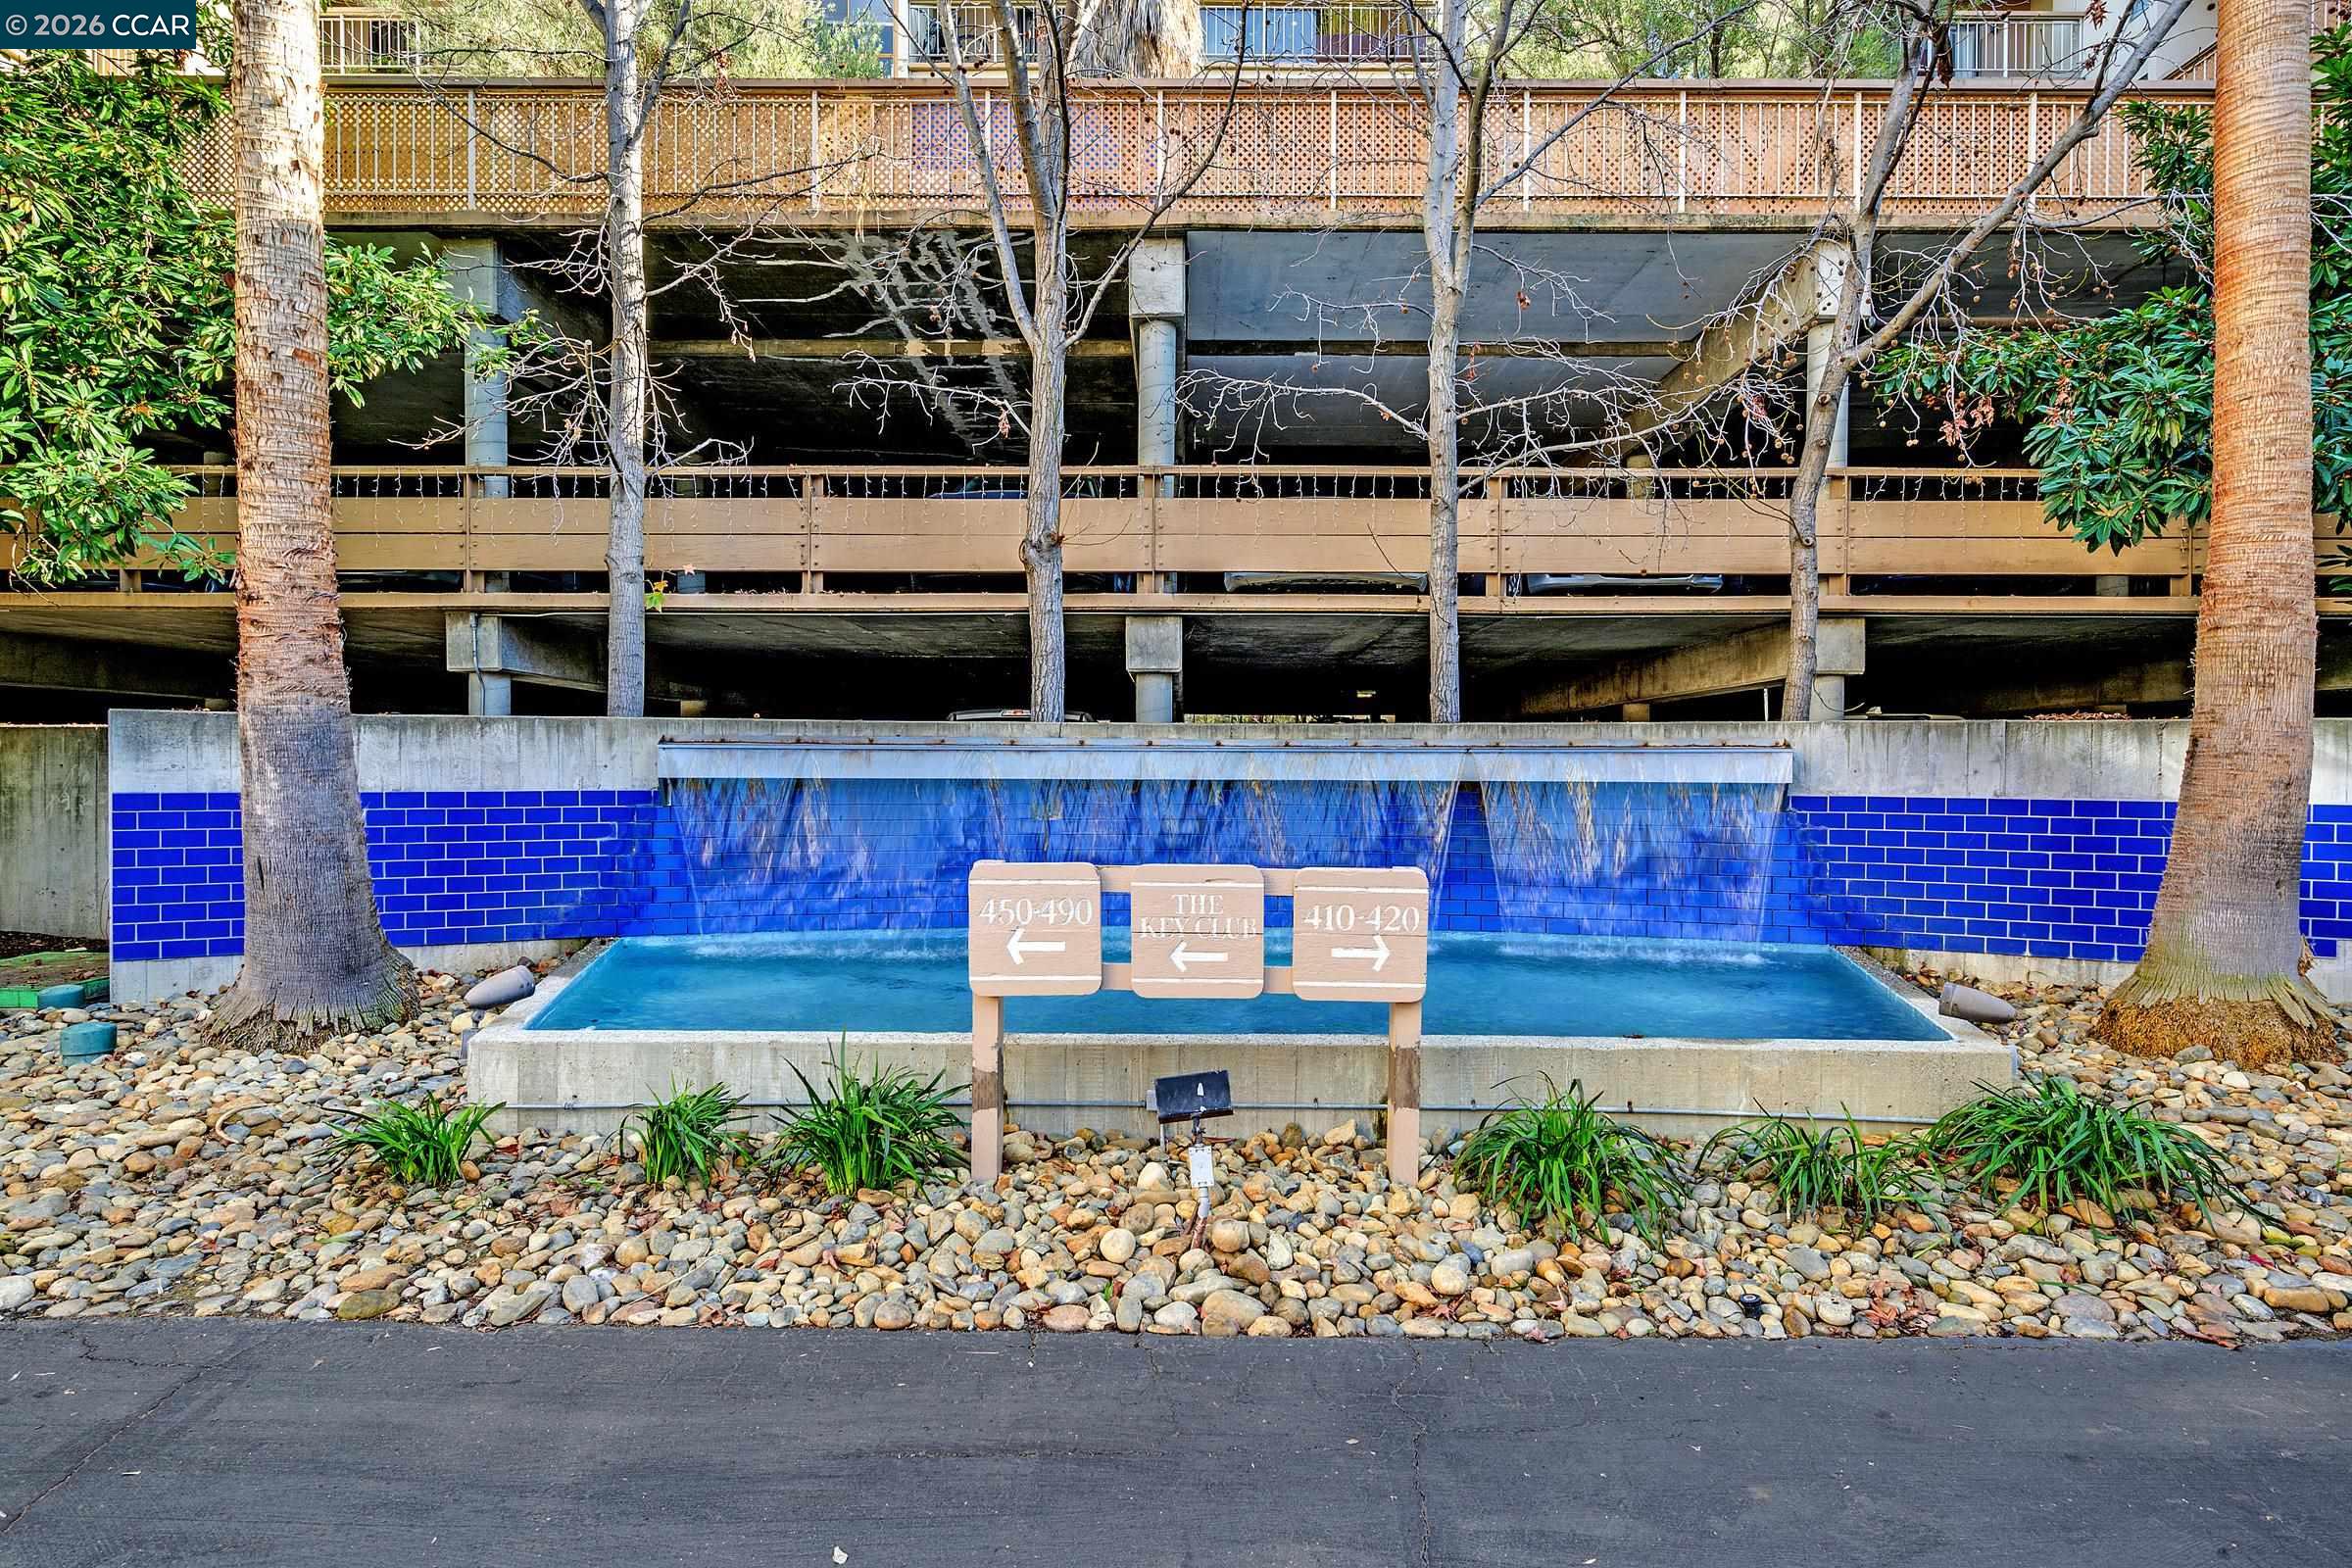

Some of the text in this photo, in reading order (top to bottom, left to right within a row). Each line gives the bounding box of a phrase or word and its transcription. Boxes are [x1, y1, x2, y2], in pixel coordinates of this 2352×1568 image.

[979, 897, 1094, 926] 450-490
[1171, 893, 1224, 915] THE
[1139, 917, 1257, 941] KEY CLUB
[1303, 904, 1420, 933] 410-420
